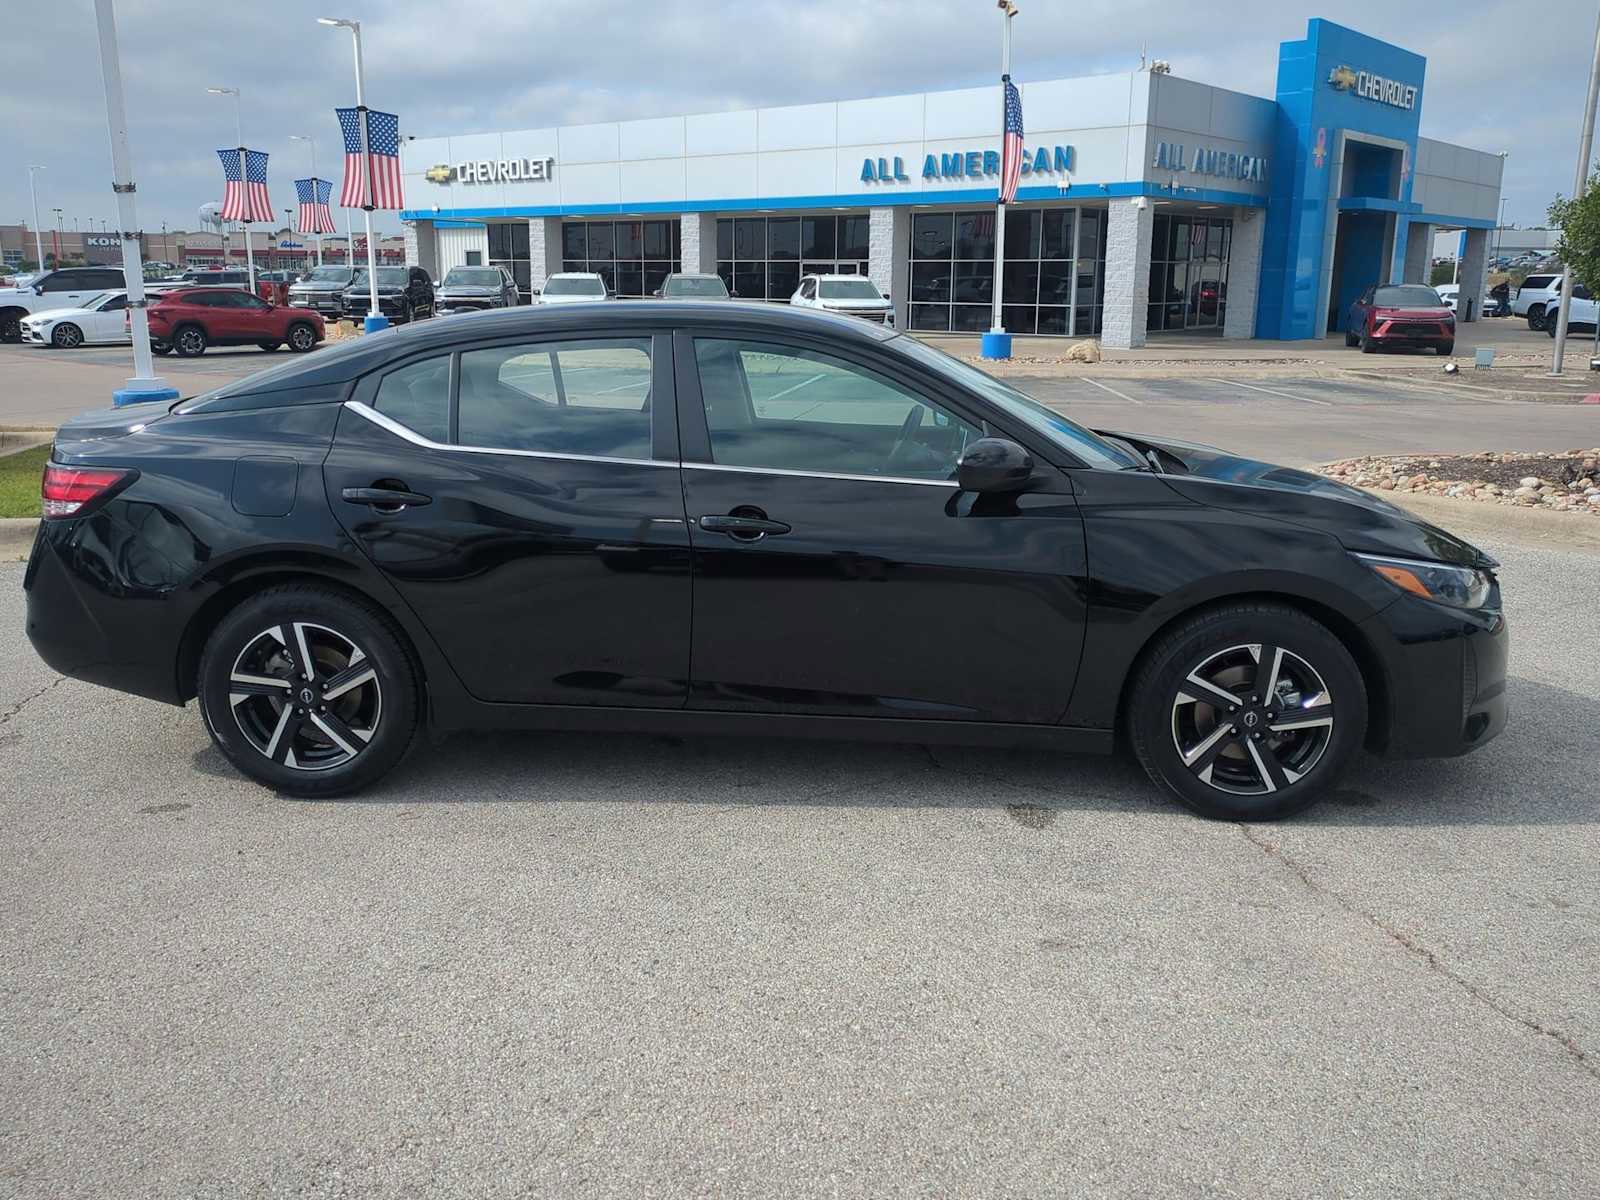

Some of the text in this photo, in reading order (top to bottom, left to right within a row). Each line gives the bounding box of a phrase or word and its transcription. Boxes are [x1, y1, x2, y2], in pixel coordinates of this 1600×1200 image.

[1358, 71, 1417, 110] CHEVROLET
[456, 158, 553, 182] CHEVROLET
[861, 146, 1075, 182] ALL AMERCAN
[1154, 142, 1268, 183] ALL AMERICAN
[88, 237, 121, 246] KOH
